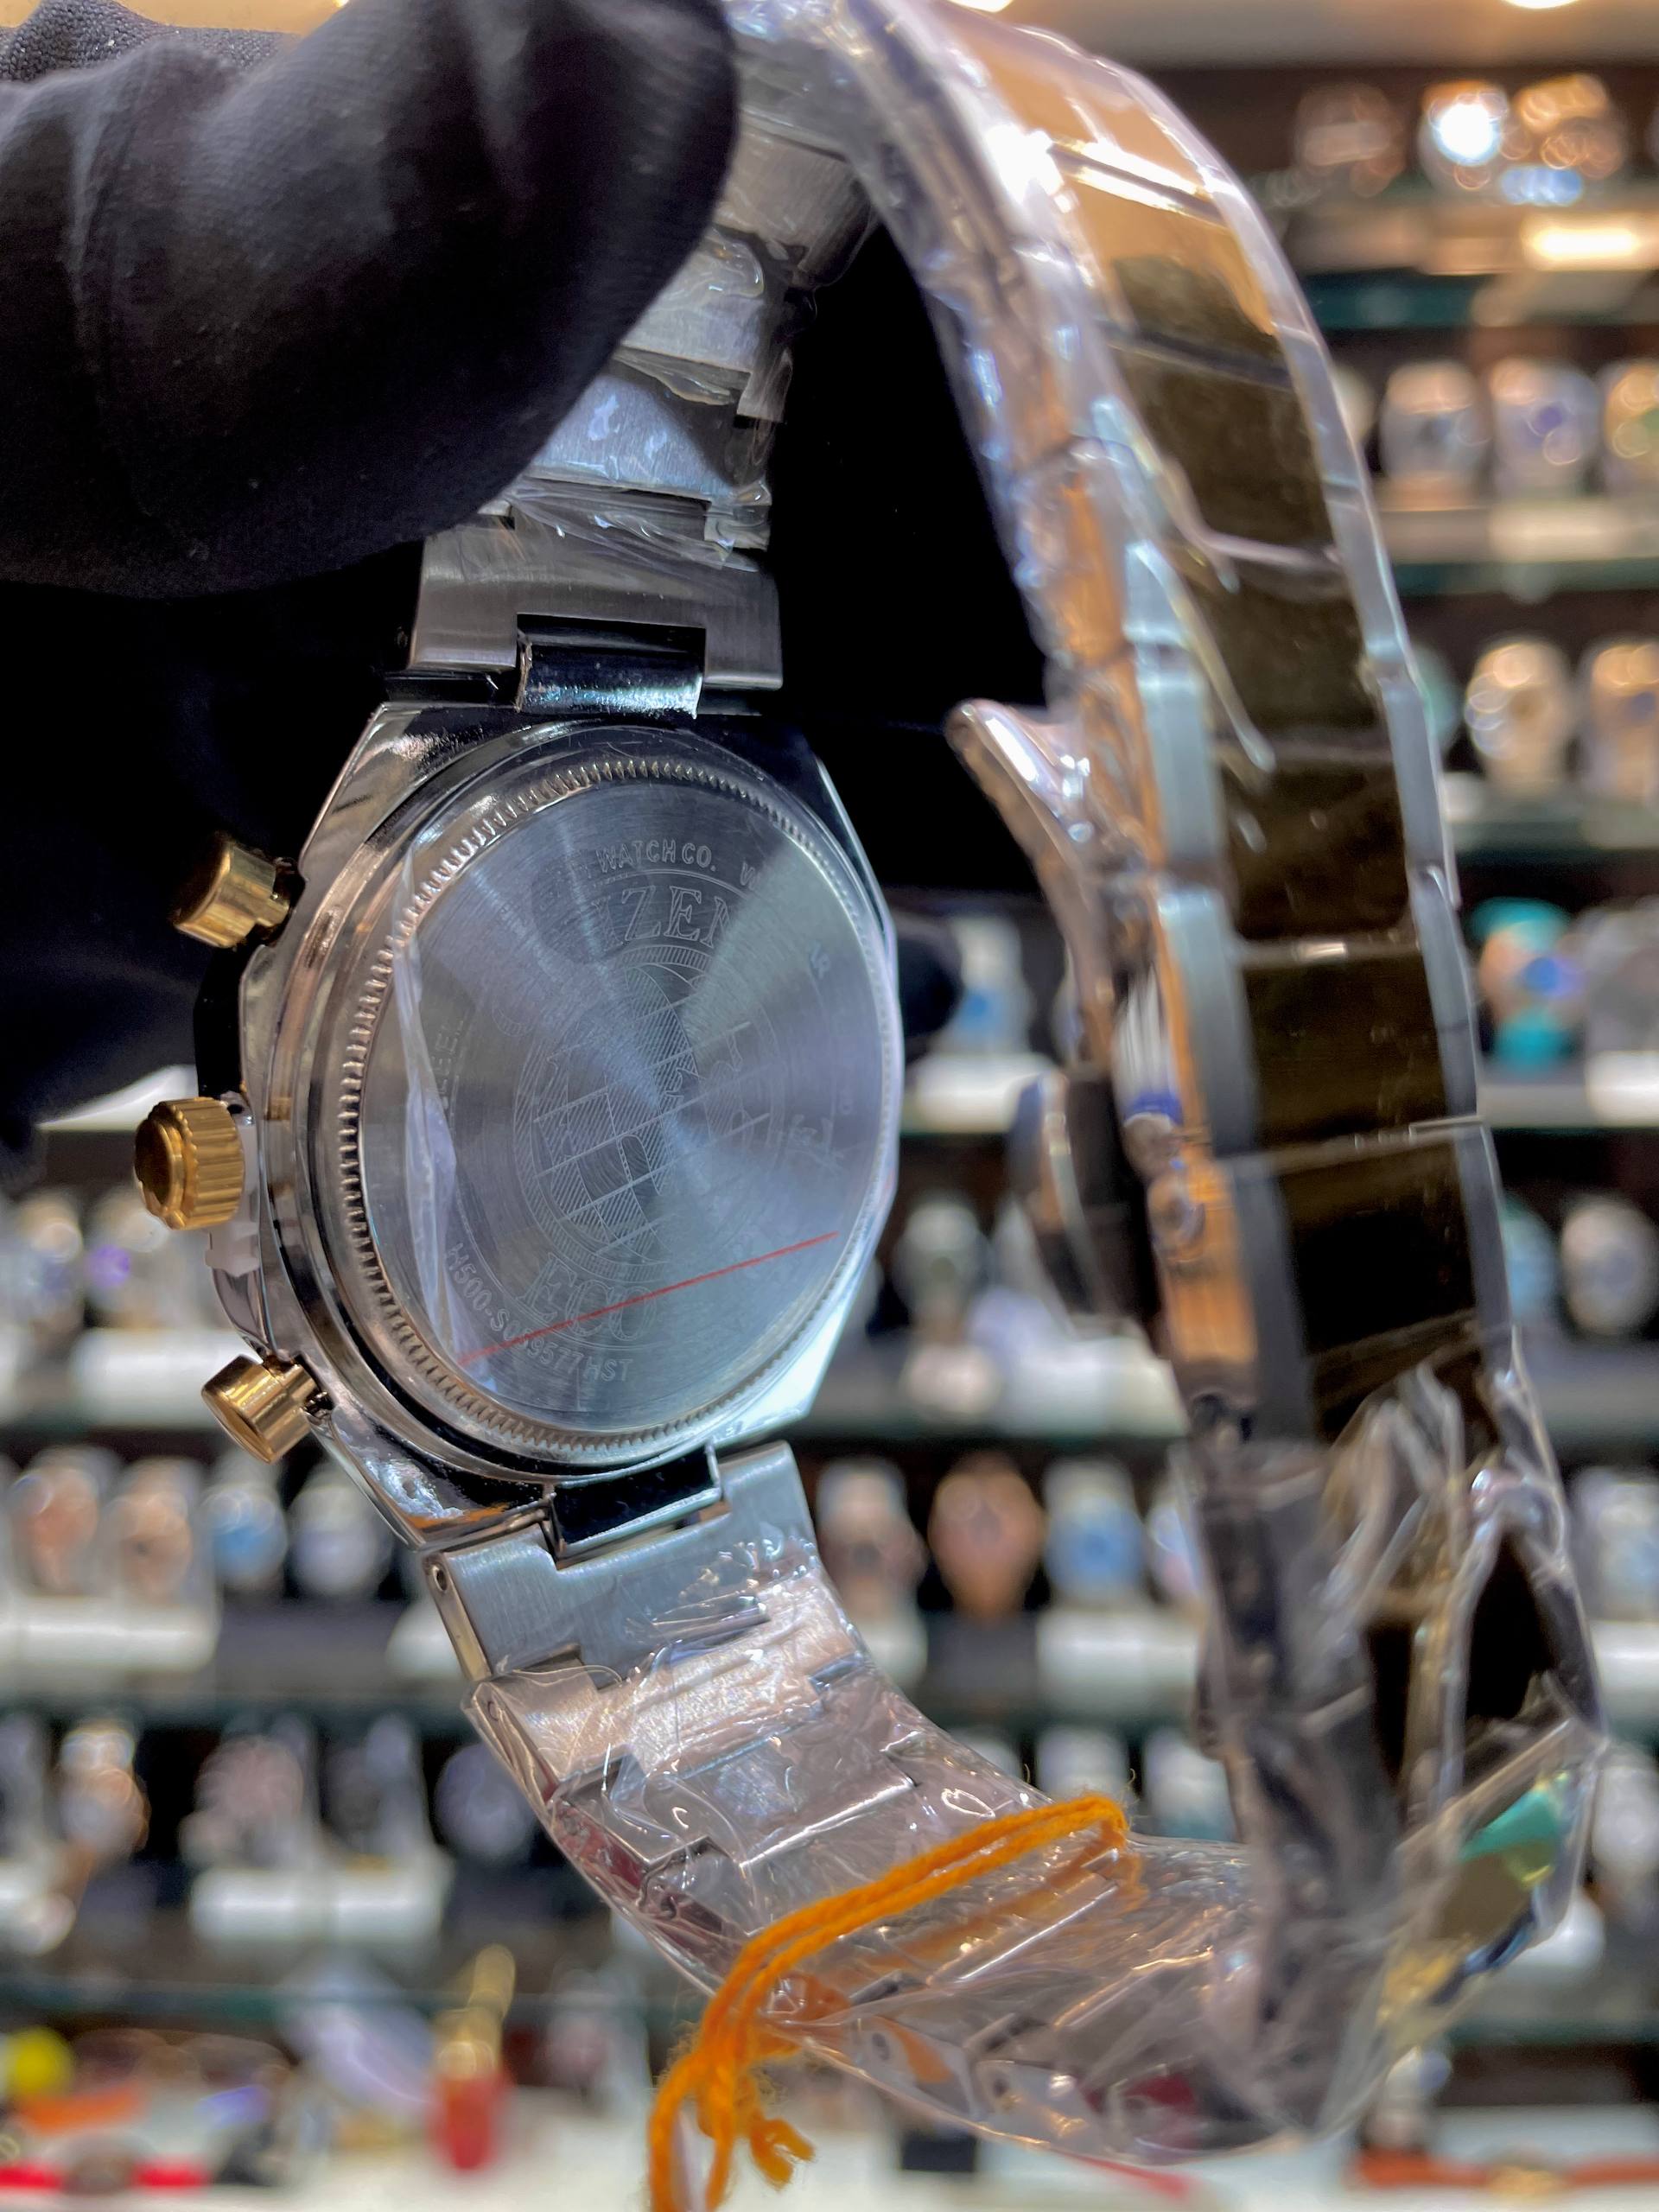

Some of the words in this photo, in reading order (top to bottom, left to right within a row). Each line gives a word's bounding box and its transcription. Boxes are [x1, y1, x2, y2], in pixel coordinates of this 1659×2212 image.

[595, 838, 677, 873] WATCH
[681, 842, 716, 872] CO.
[519, 1251, 657, 1340] ECO
